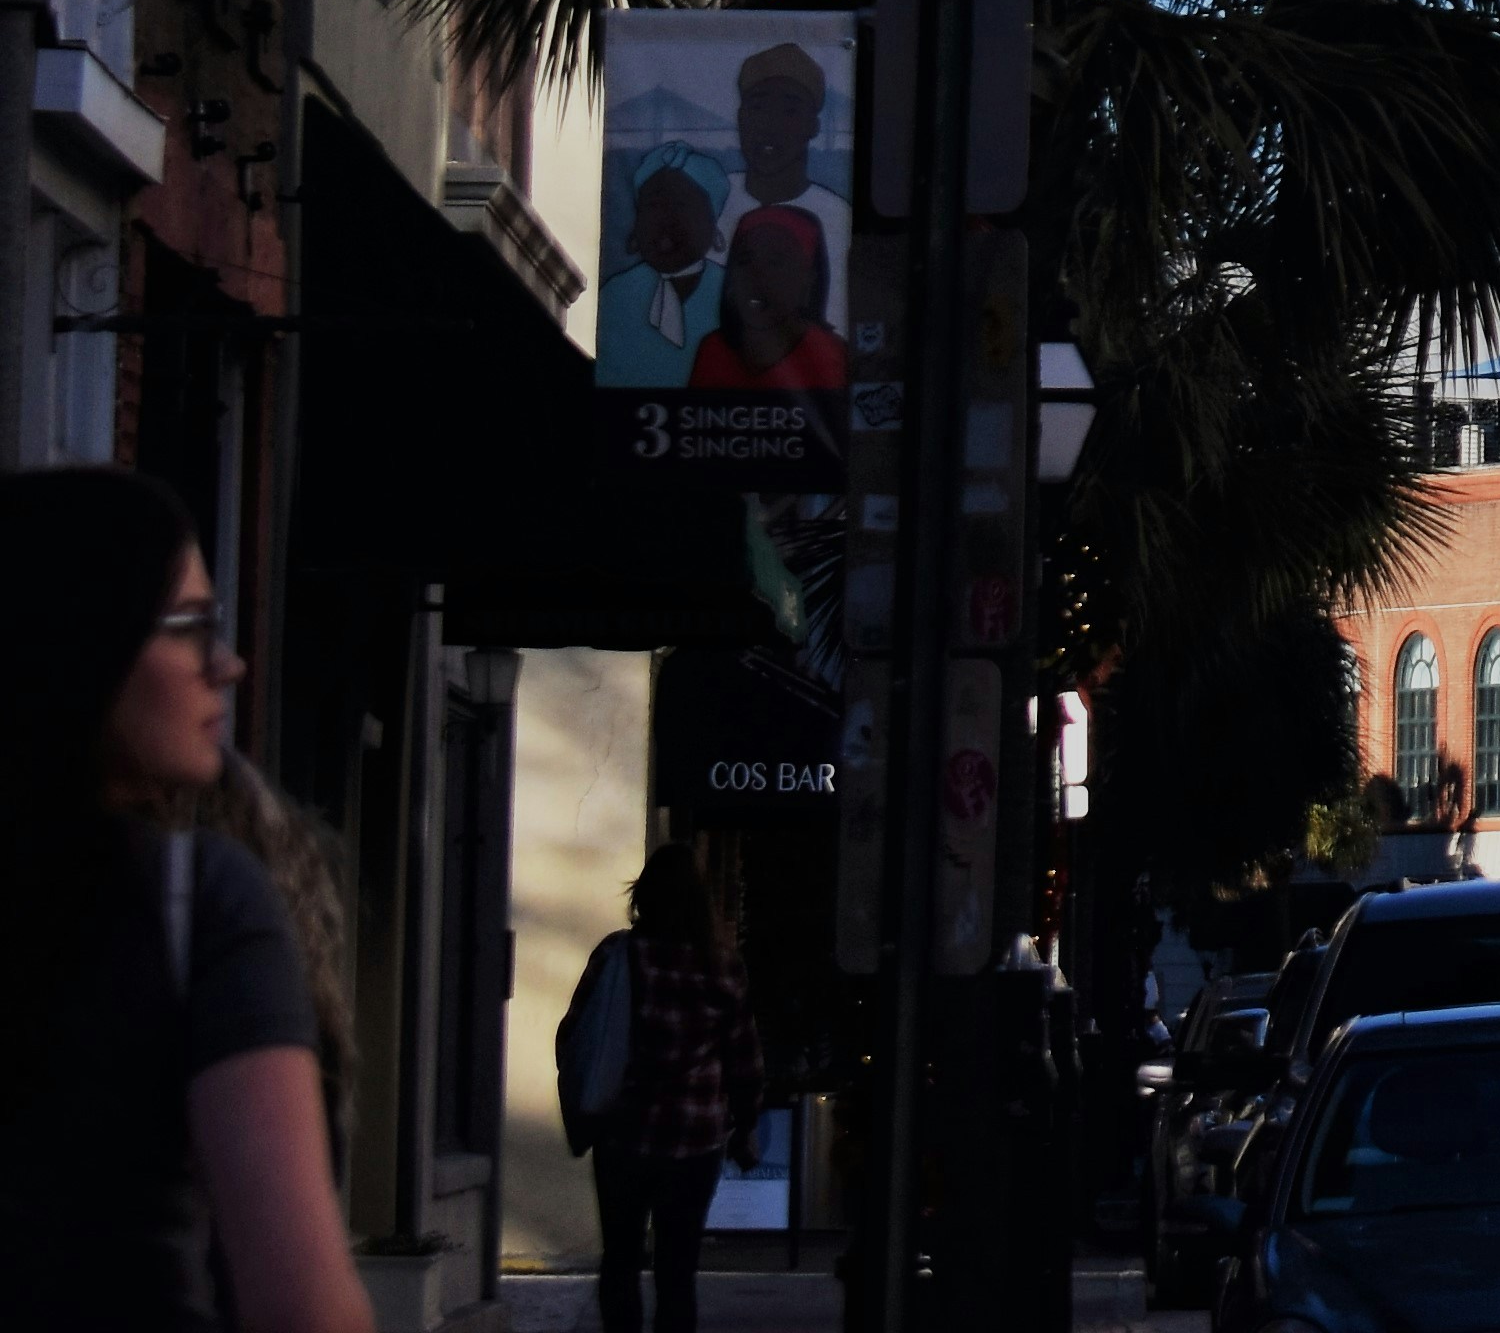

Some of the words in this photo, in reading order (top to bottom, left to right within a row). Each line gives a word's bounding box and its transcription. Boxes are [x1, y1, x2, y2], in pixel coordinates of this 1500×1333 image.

[632, 402, 672, 459] 3
[678, 405, 806, 430] SINGERS
[678, 435, 806, 459] SINGING
[710, 760, 768, 791] COS
[778, 761, 836, 794] BAR
